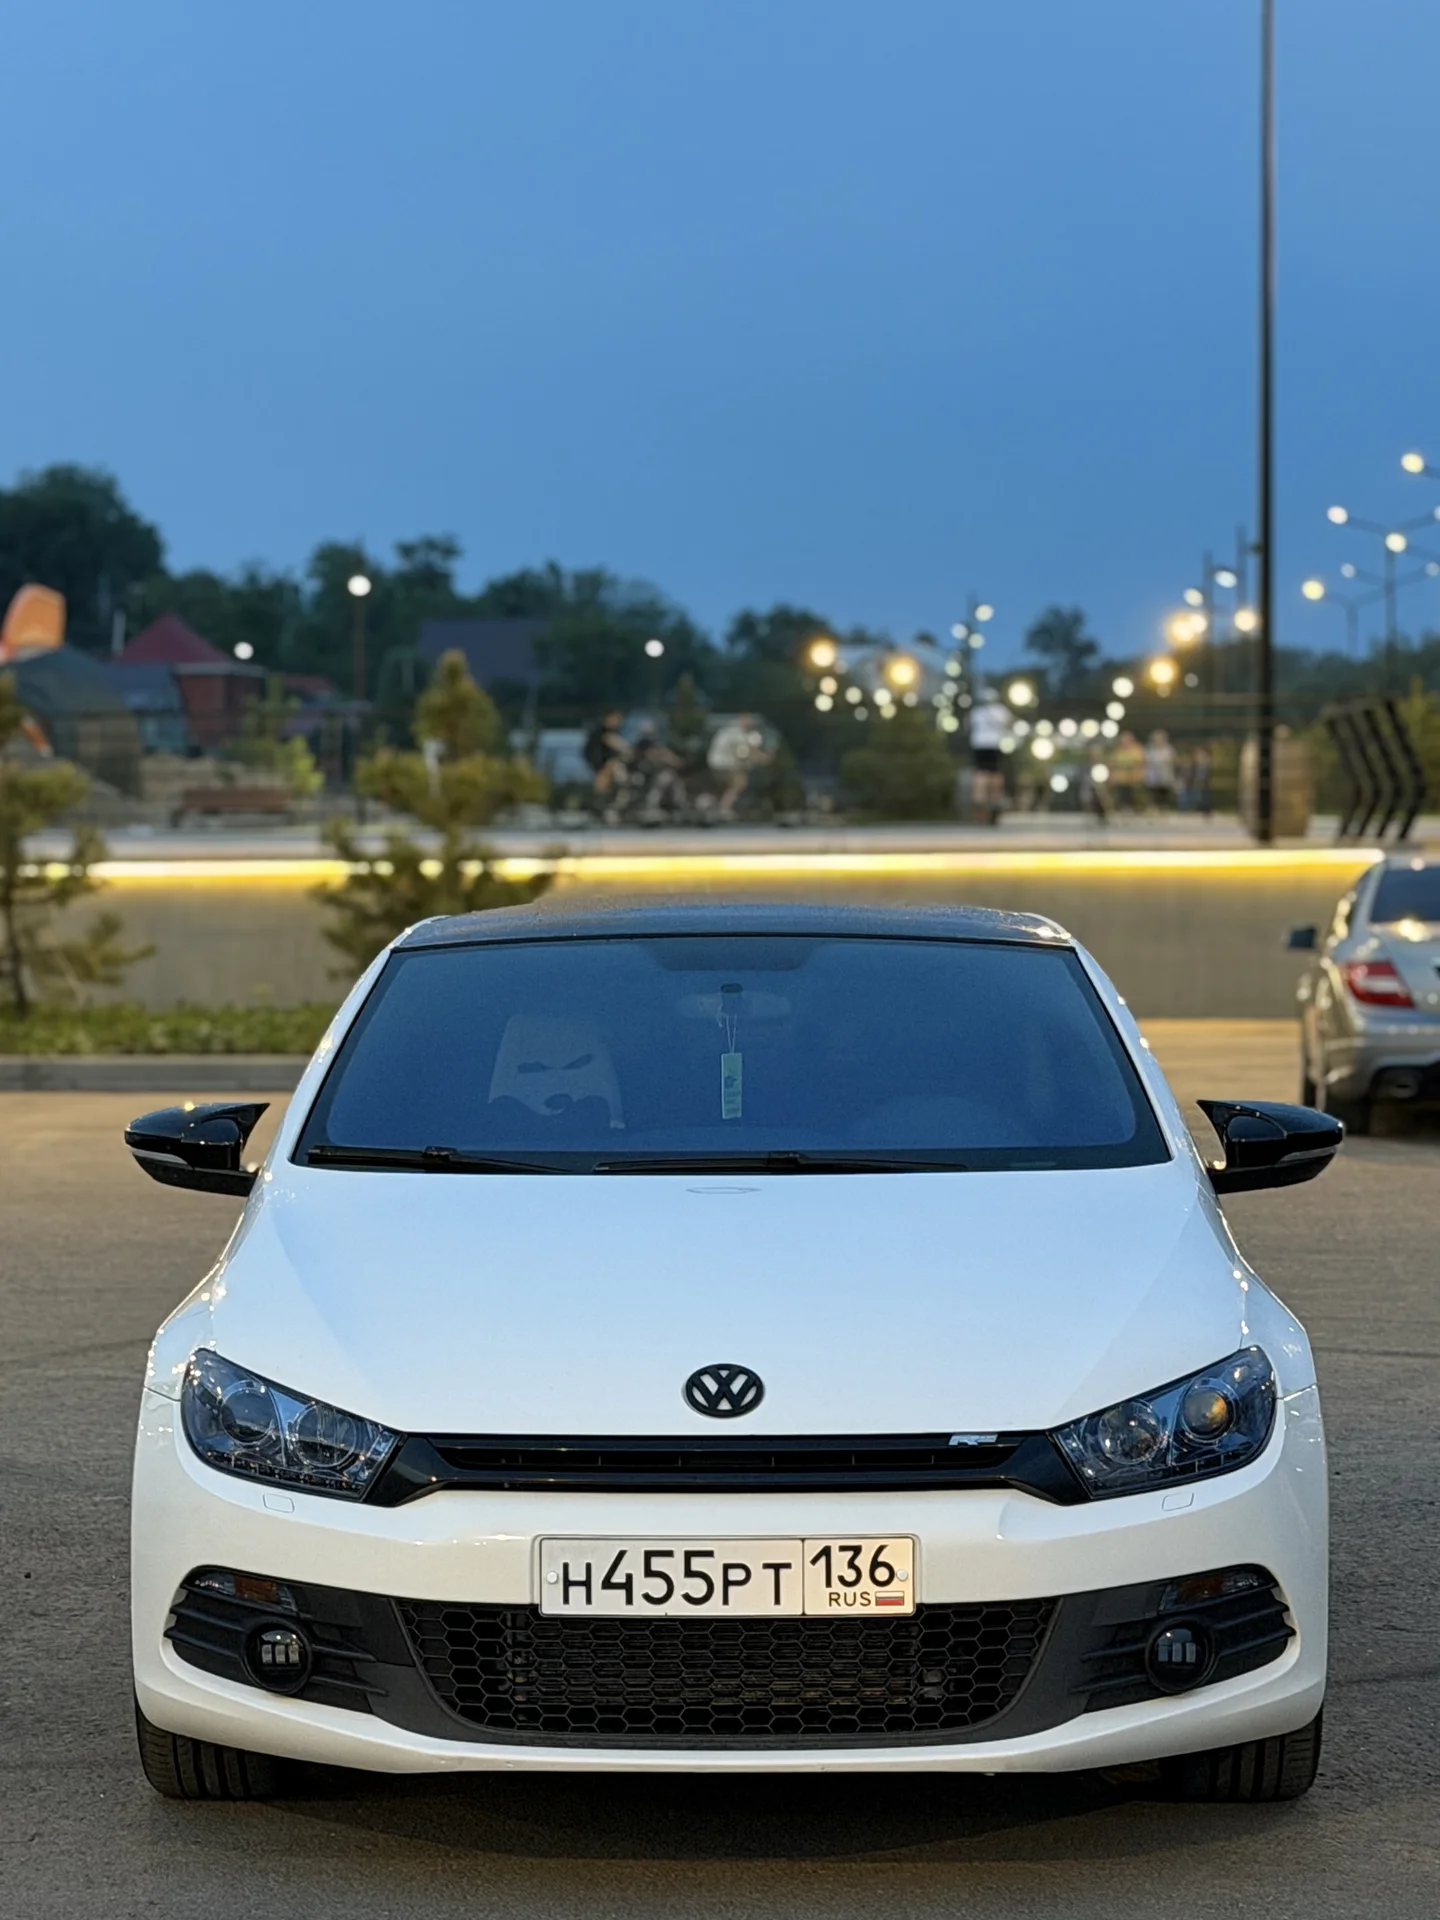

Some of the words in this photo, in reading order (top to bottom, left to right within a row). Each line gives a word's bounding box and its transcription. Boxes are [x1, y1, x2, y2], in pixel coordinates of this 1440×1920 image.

[685, 1363, 765, 1418] VW
[809, 1545, 896, 1589] 136
[828, 1592, 872, 1607] RUS
